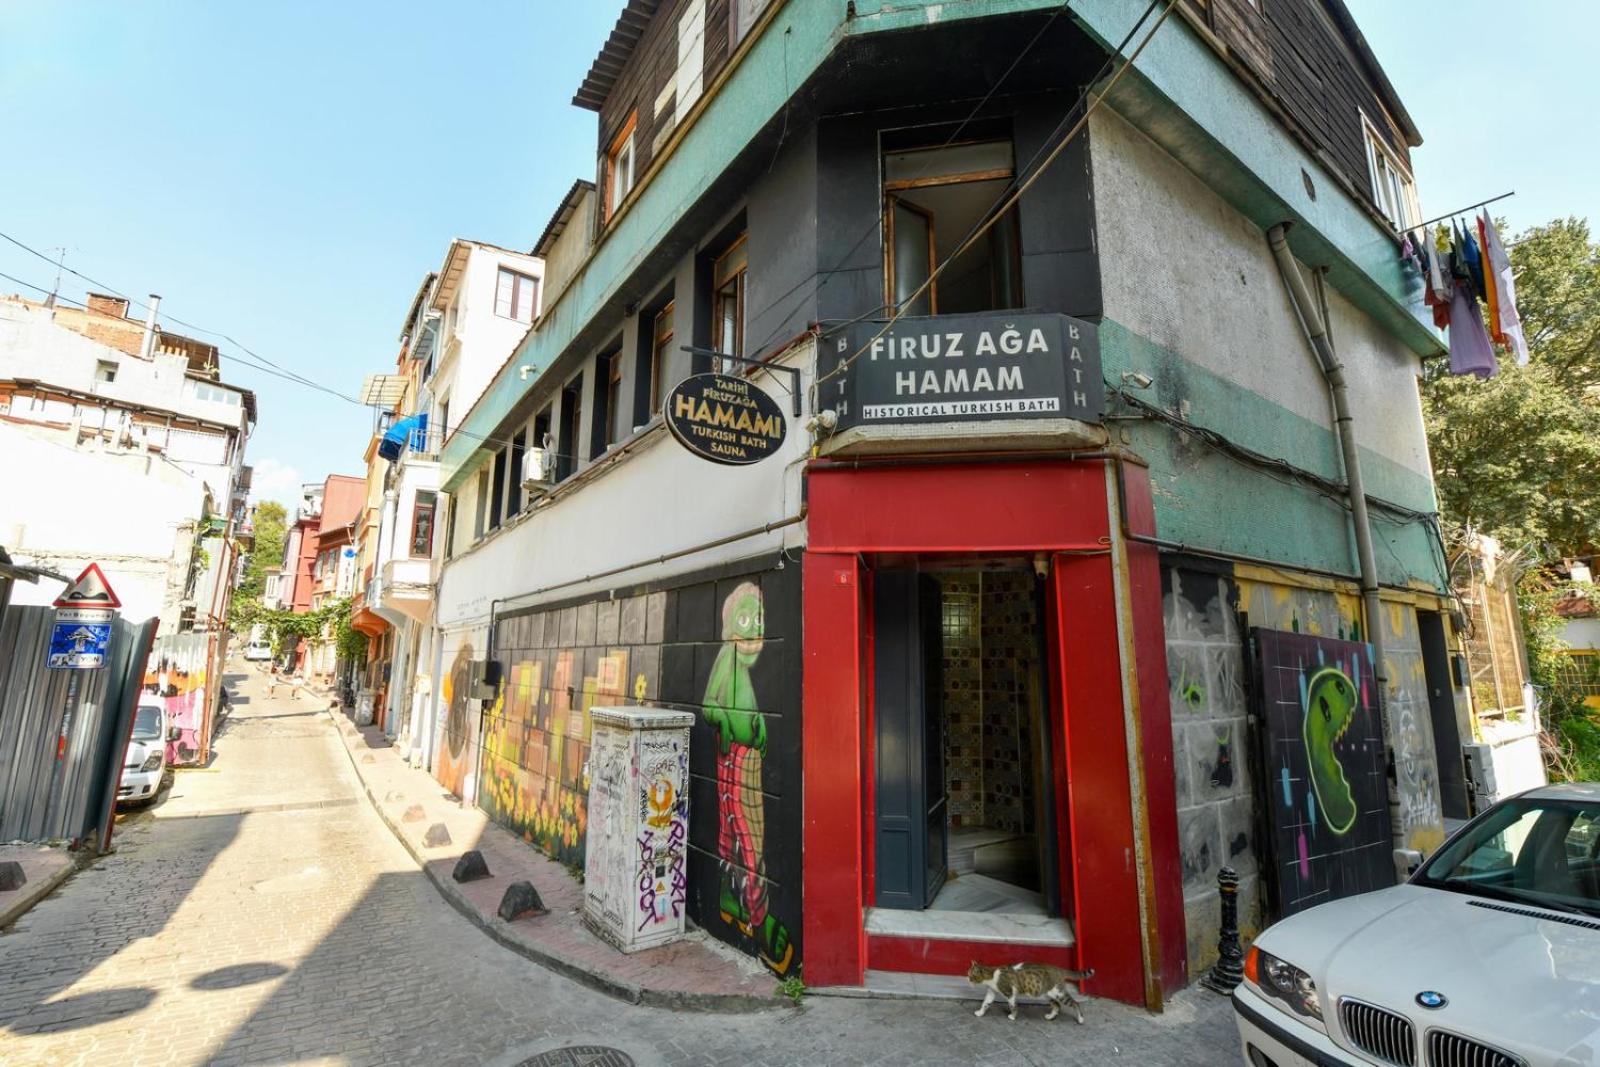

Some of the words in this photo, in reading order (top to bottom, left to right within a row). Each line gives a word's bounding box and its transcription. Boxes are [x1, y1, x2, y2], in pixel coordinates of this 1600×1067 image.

[870, 331, 964, 360] FİRUZ
[975, 323, 1049, 356] AĞA
[1069, 323, 1087, 408] BATH
[716, 379, 748, 394] TARİHİ
[895, 366, 1024, 396] HAMAM
[675, 393, 781, 439] HAMAMI
[864, 405, 947, 418] HISTORICAL
[951, 402, 1013, 414] TURKISH
[1018, 400, 1055, 411] BATH
[692, 425, 736, 442] TURKISH
[741, 435, 767, 449] BATH
[711, 442, 746, 458] SAUNA
